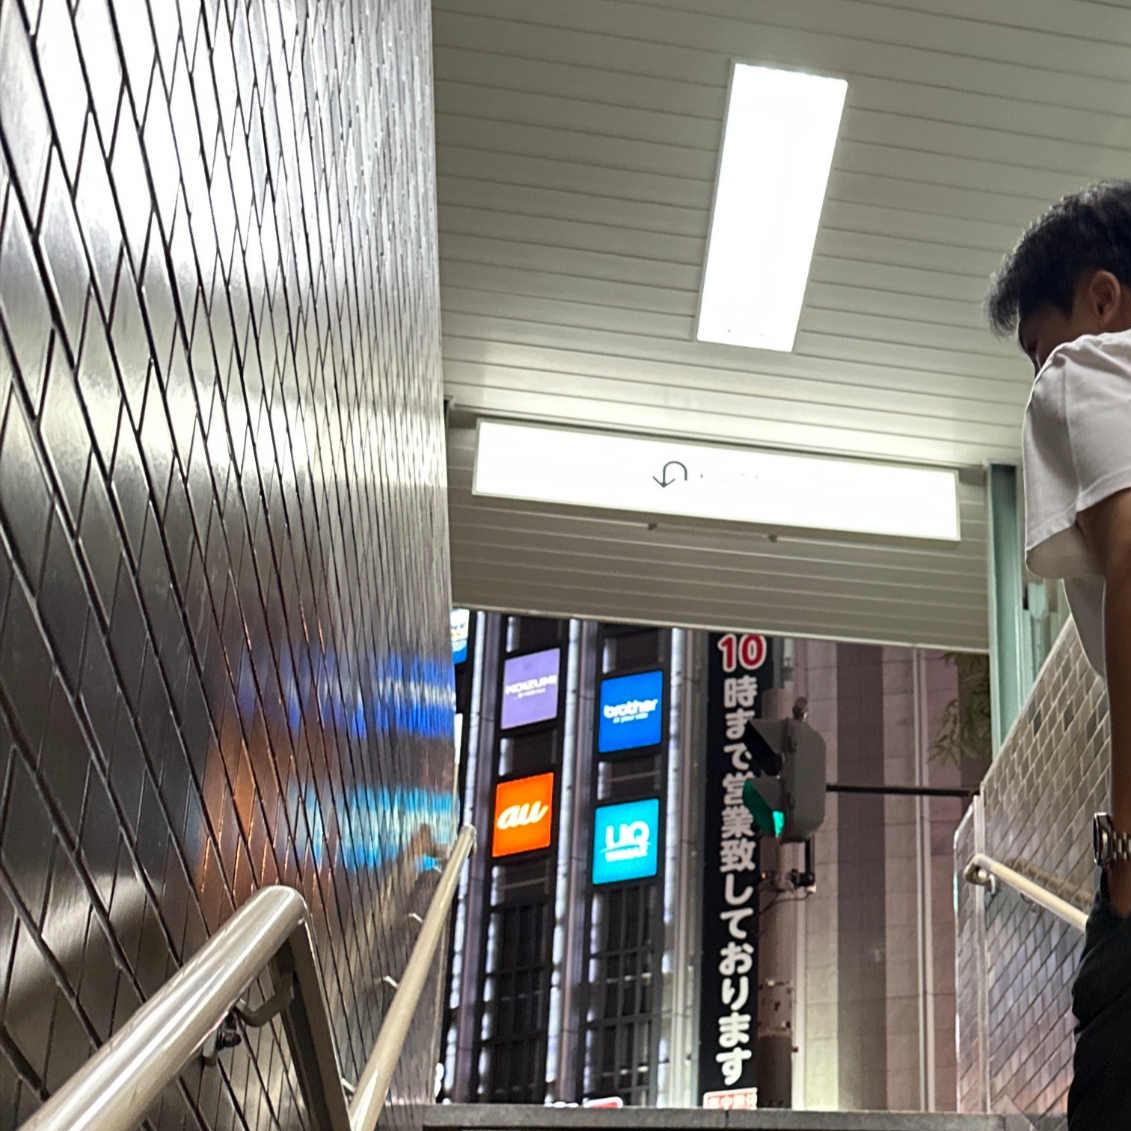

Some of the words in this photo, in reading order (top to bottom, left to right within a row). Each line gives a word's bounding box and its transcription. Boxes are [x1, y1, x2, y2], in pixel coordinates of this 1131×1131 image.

[603, 698, 658, 719] brother
[497, 800, 549, 830] au
[605, 820, 650, 850] UQ
